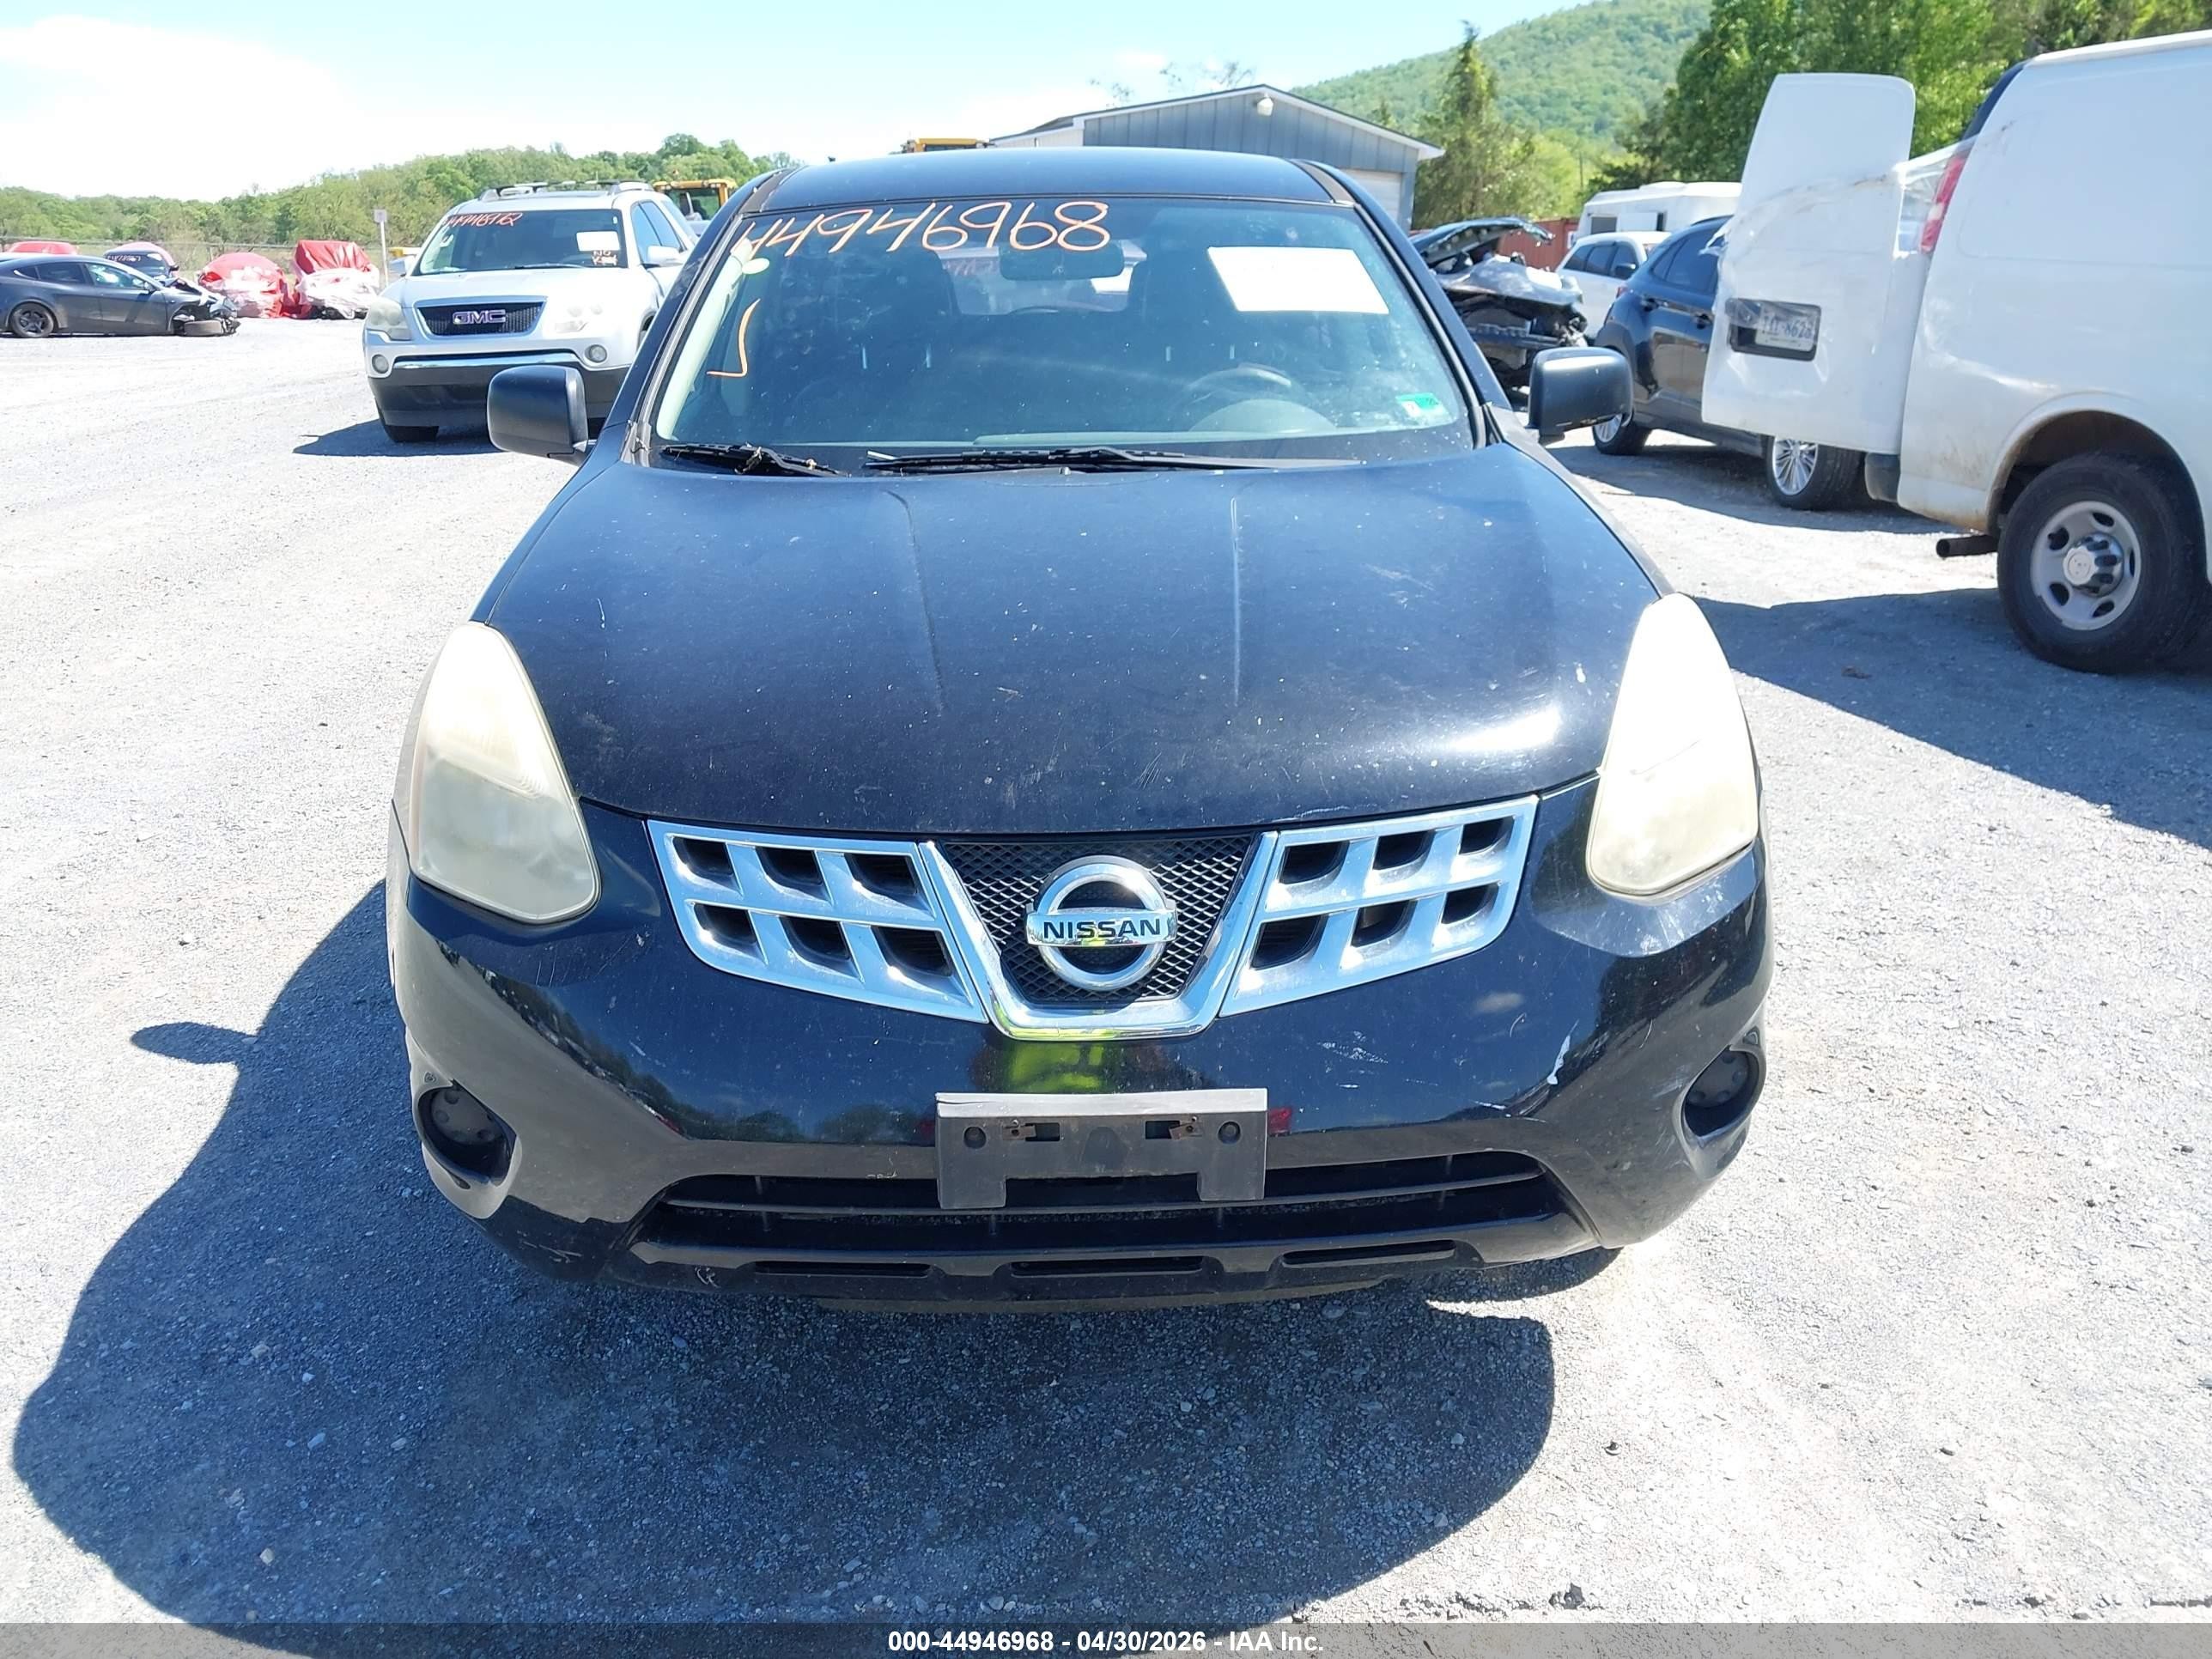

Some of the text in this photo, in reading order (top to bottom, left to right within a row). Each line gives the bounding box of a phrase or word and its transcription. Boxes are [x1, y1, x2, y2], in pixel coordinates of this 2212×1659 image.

[730, 199, 1111, 258] 44946968
[453, 309, 506, 325] GMC
[1043, 918, 1160, 939] NISSAN
